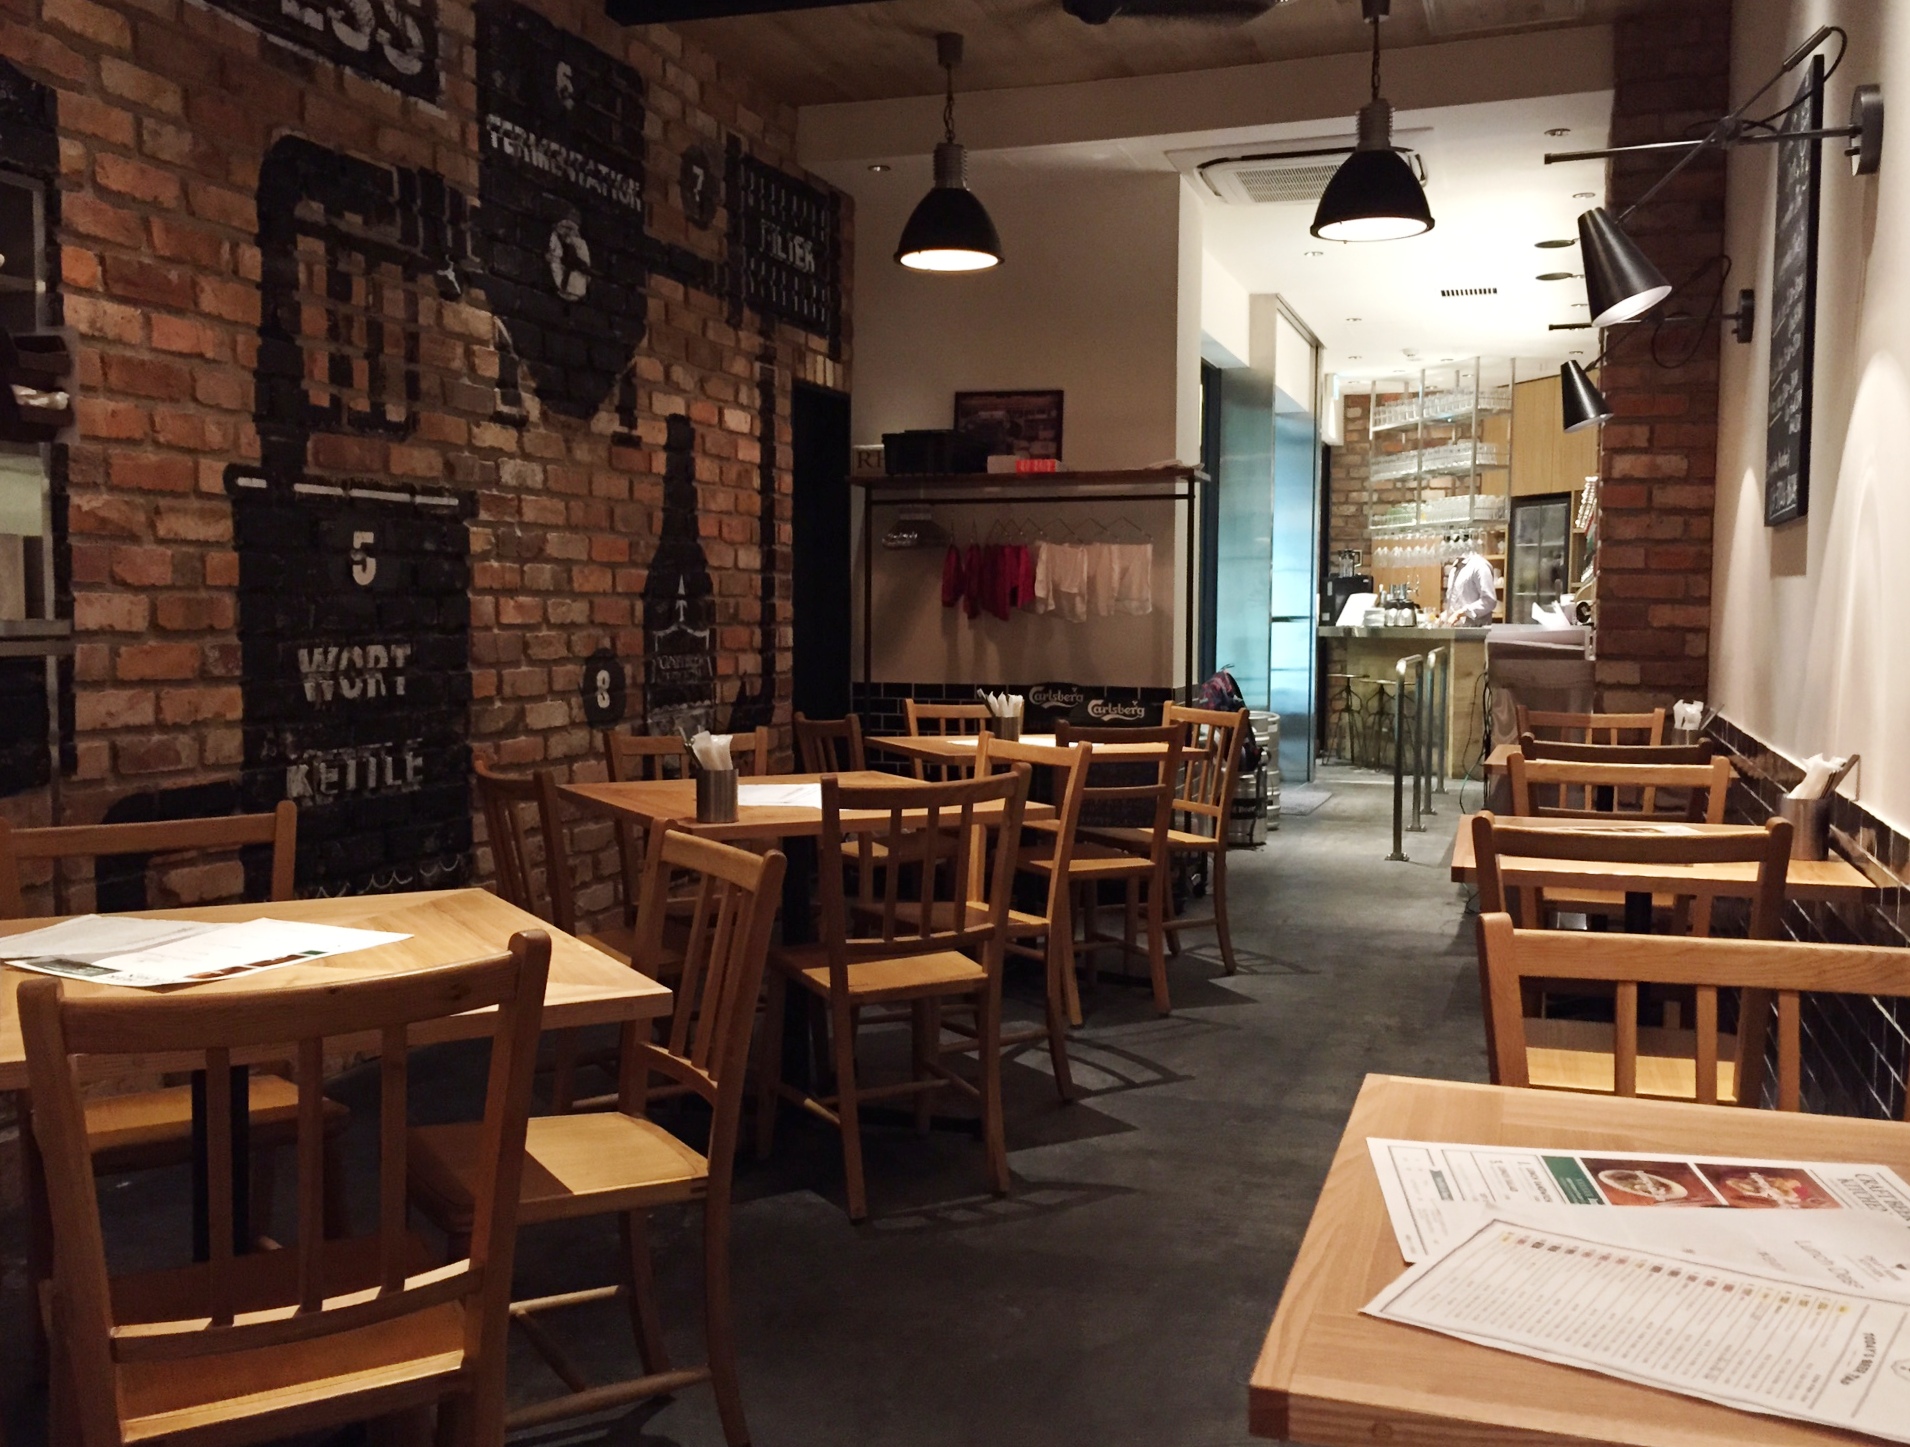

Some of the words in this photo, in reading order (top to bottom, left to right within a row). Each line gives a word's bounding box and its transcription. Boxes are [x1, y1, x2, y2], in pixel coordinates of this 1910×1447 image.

[486, 113, 642, 212] FERMENTATION
[692, 165, 704, 202] 7
[760, 219, 815, 273] FILTER
[349, 531, 377, 586] 5
[296, 644, 411, 703] WORT
[595, 670, 610, 708] 8
[1029, 686, 1084, 706] Carlsberg
[1087, 699, 1145, 720] Carlsberg
[284, 738, 424, 804] KETTLE
[1855, 1174, 1896, 1199] CRAFT
